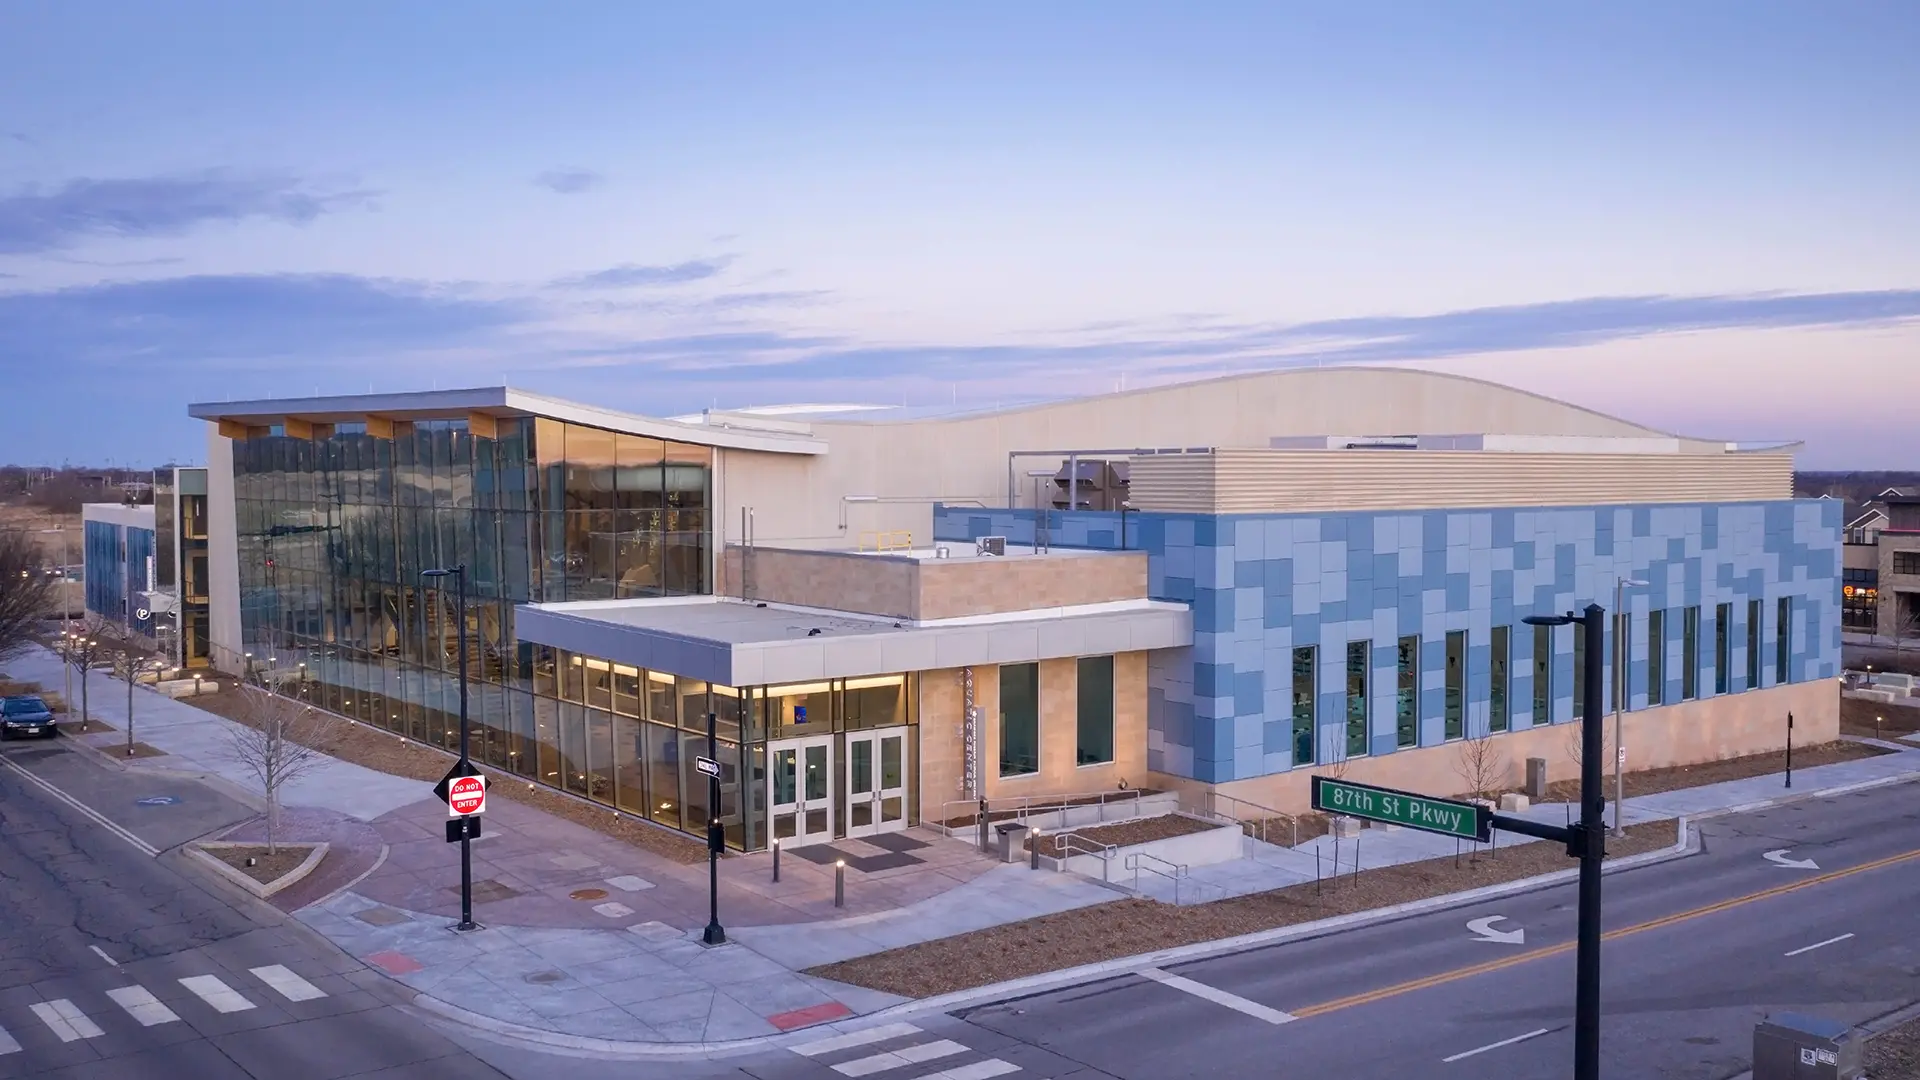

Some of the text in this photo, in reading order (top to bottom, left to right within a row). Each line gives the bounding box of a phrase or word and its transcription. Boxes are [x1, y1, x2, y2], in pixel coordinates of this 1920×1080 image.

[457, 800, 477, 808] ENTER
[1333, 788, 1461, 831] 87th St Pkwy
